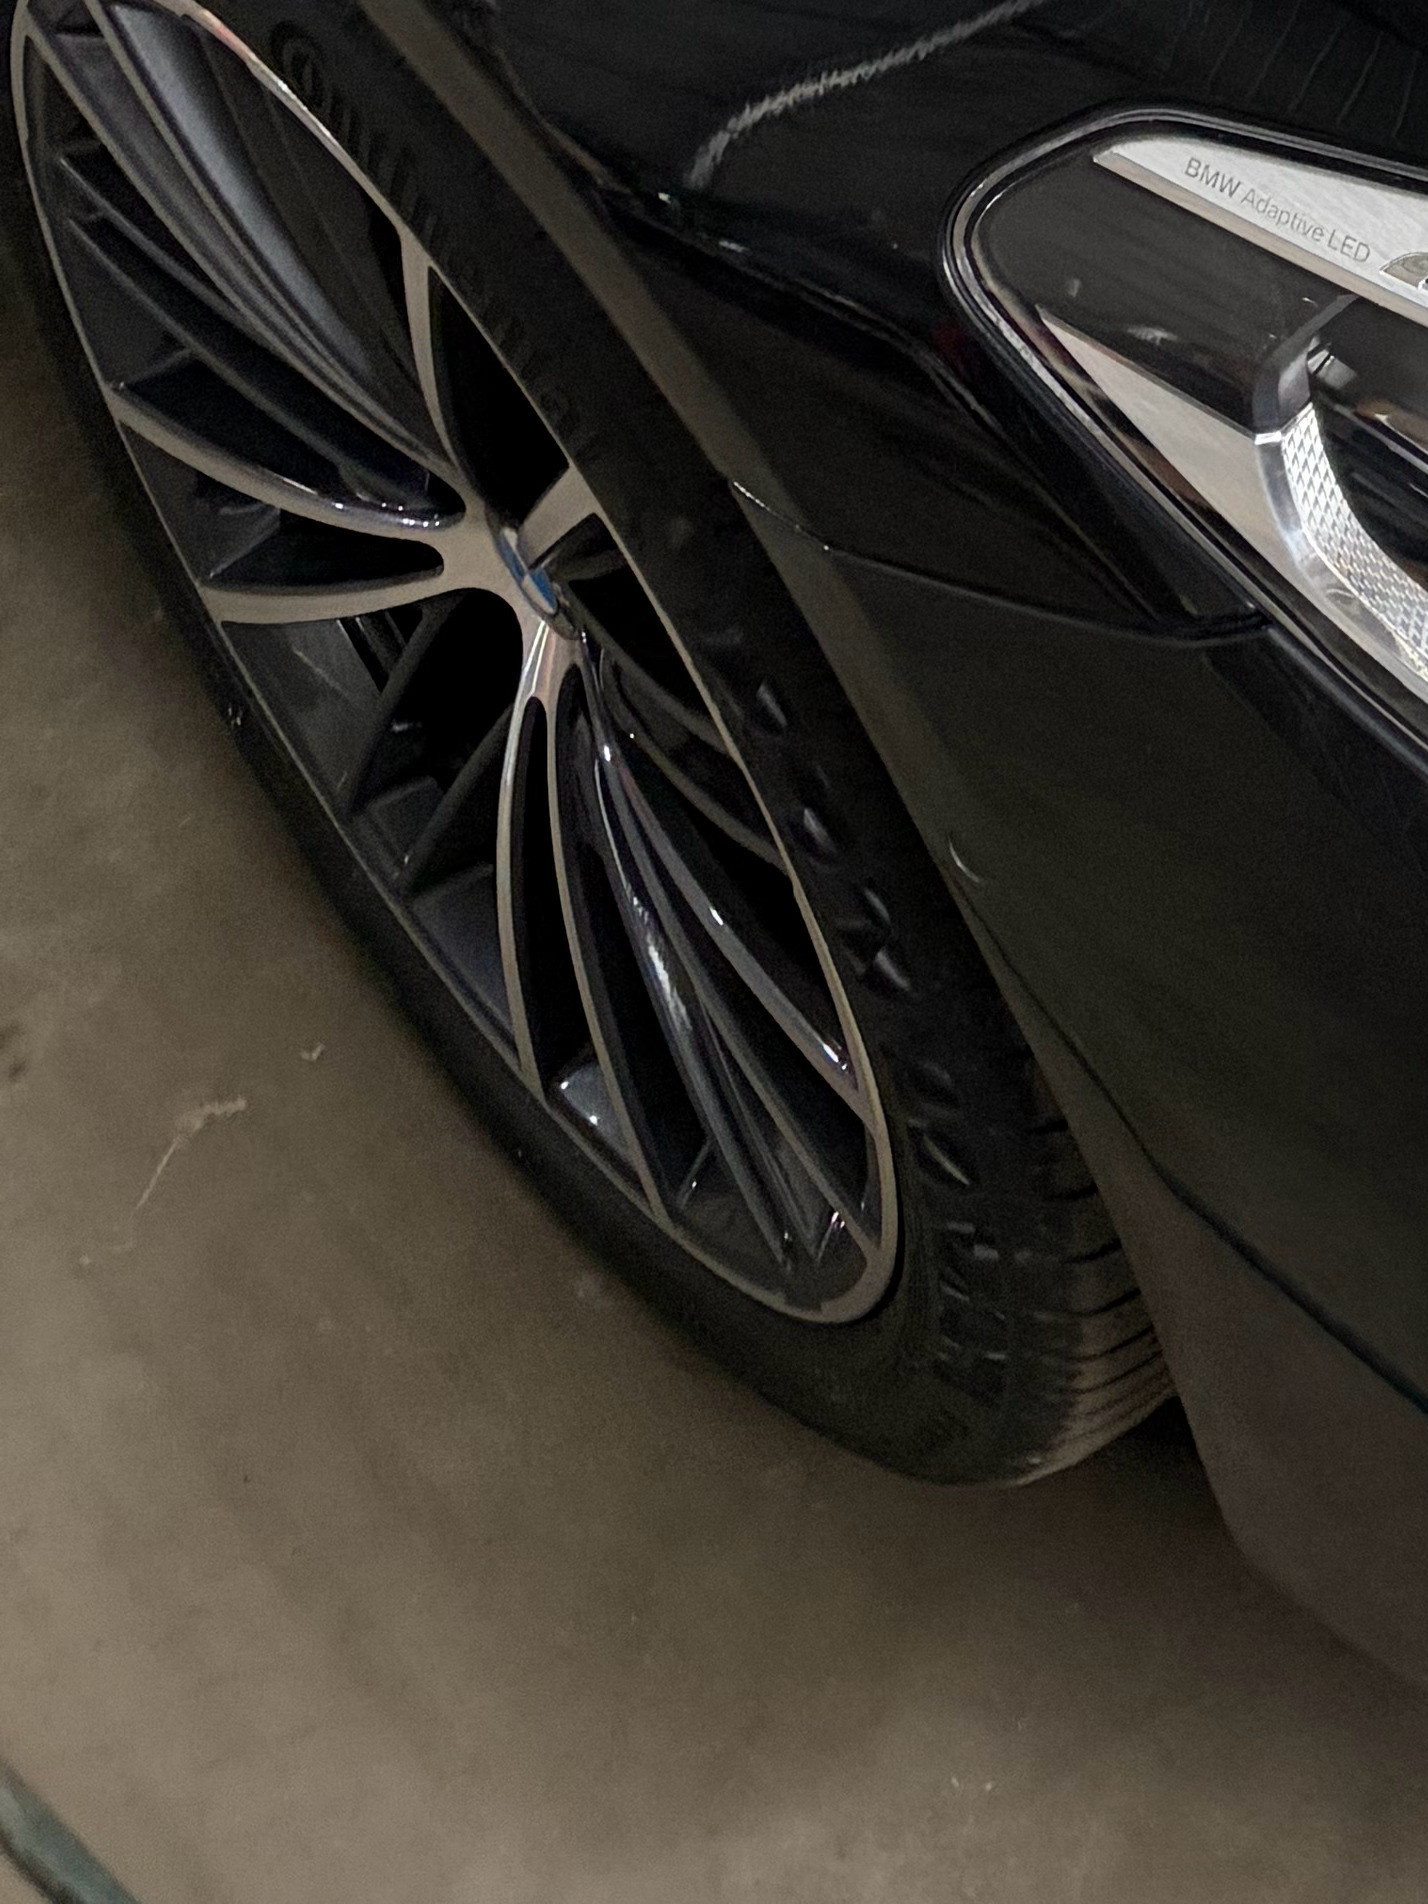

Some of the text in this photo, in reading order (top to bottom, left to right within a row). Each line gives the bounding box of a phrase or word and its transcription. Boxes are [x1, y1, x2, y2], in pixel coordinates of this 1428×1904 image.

[1184, 156, 1371, 264] BMW Adaptive LED
